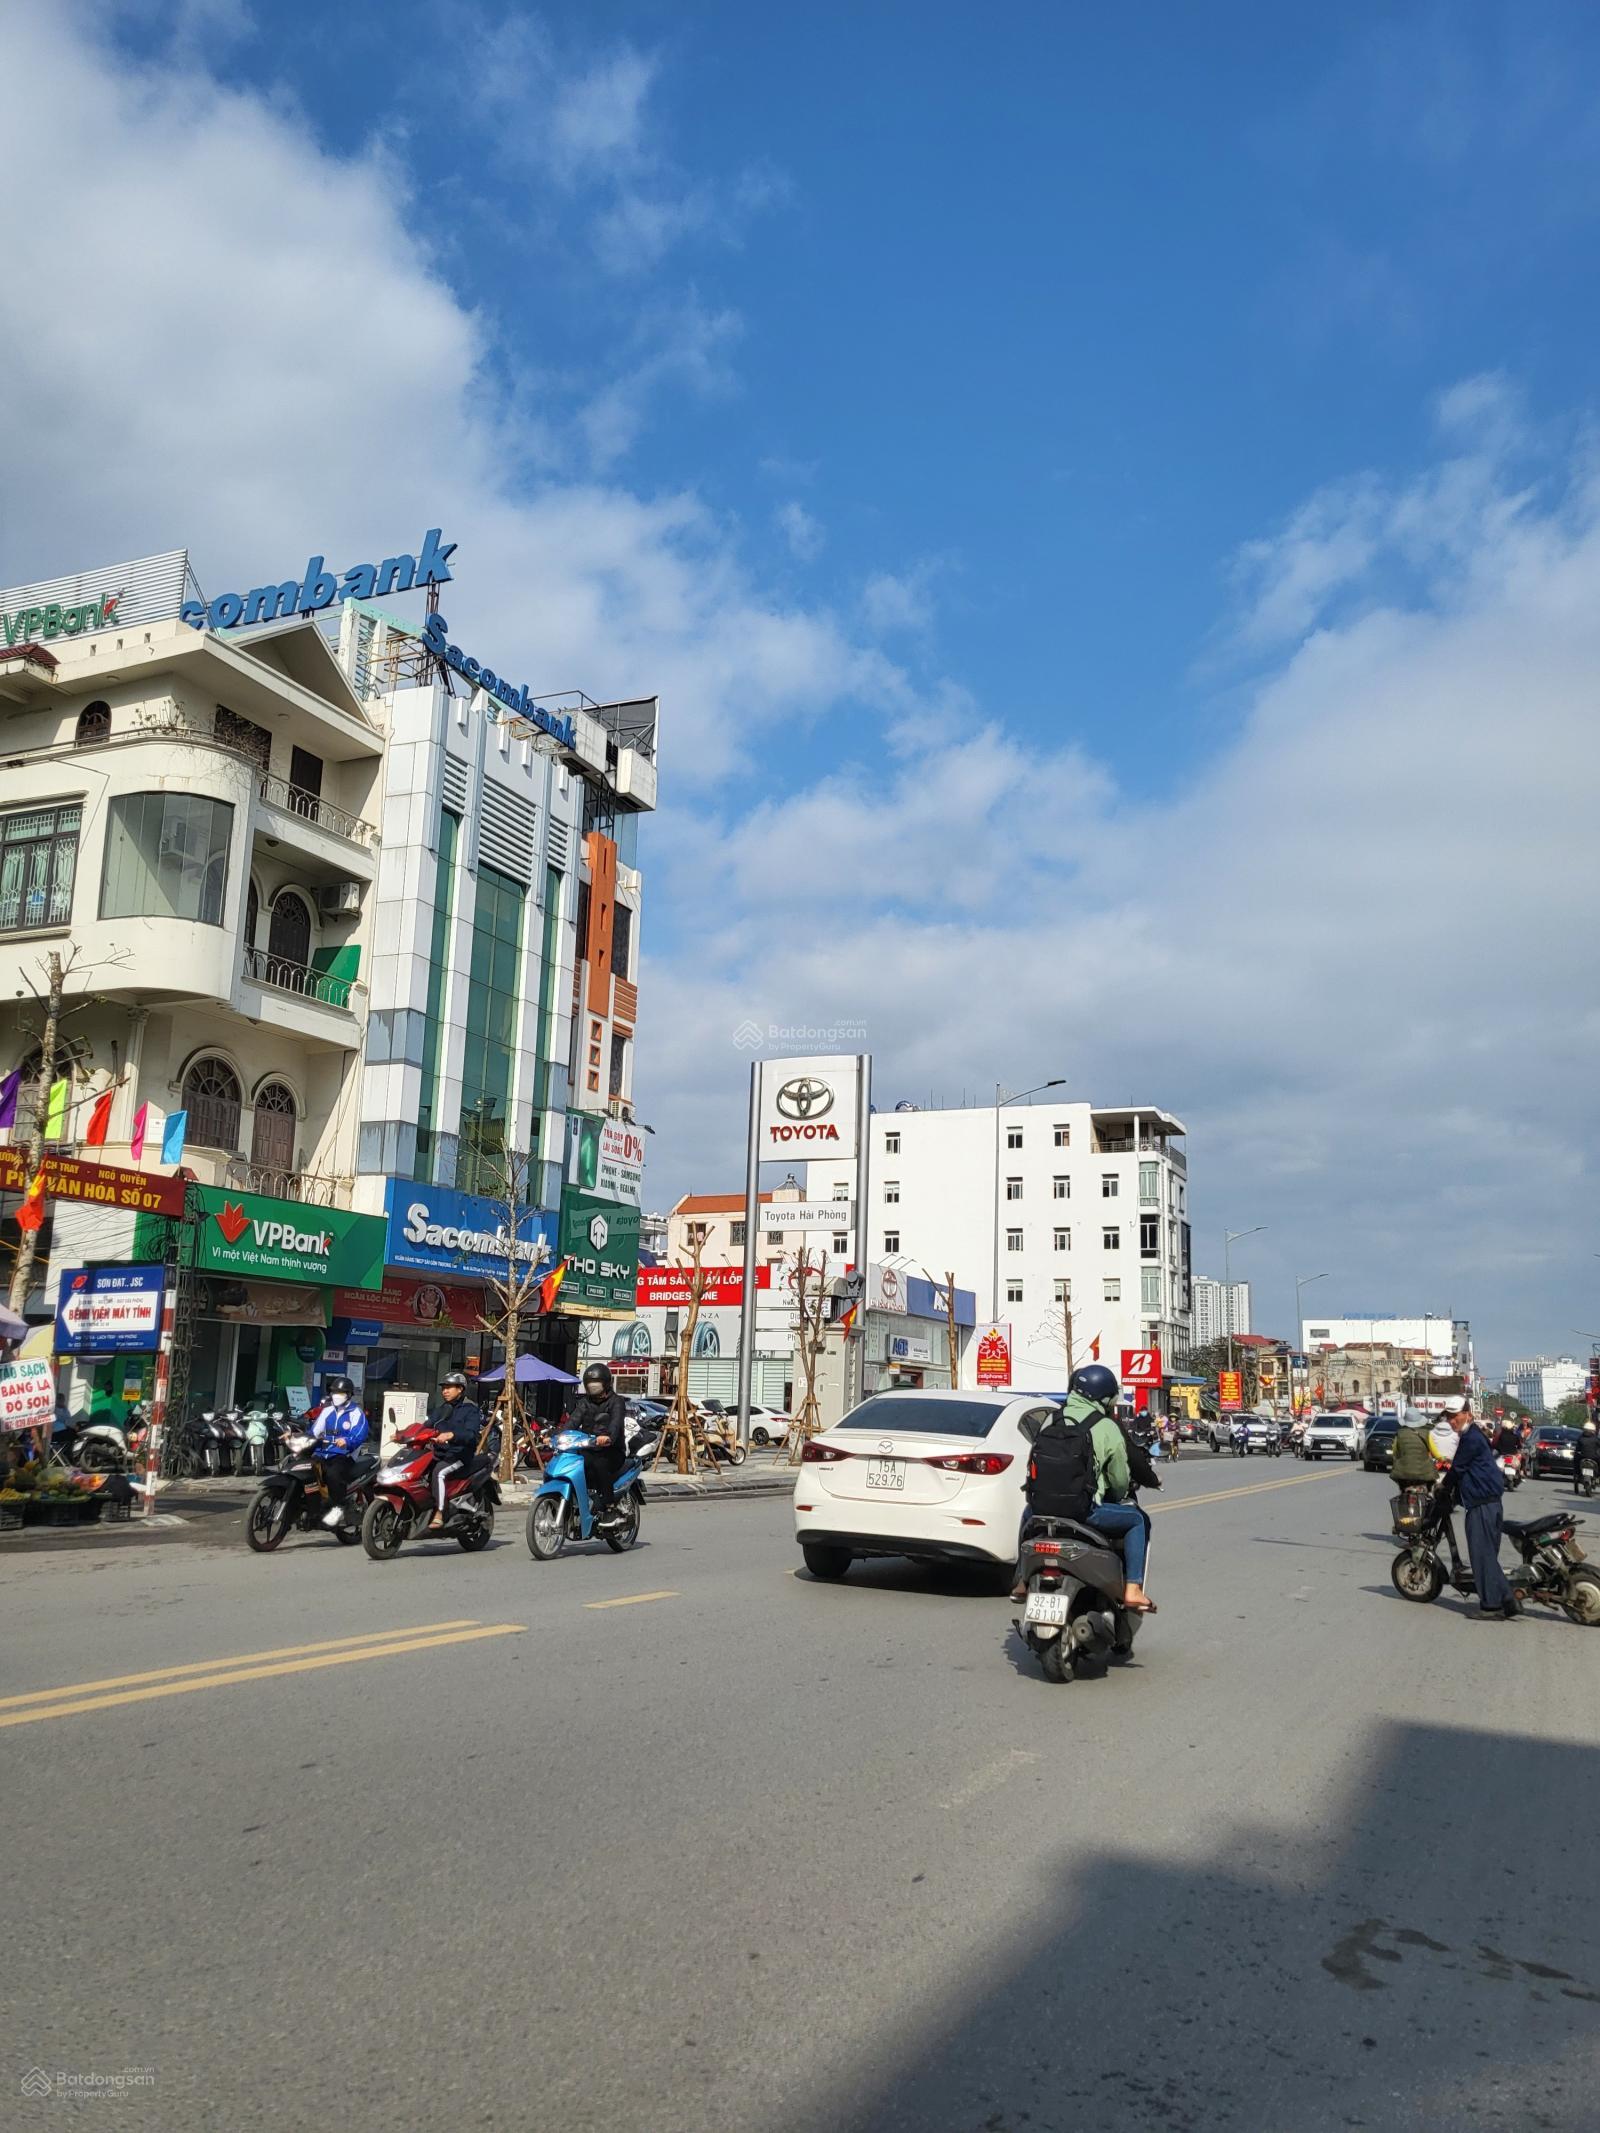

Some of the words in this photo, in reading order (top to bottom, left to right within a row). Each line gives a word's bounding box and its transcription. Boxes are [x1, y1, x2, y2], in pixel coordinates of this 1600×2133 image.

[3, 592, 119, 645] VPBank
[421, 613, 578, 750] Sacombank
[770, 1124, 840, 1143] TOYOTA
[624, 1134, 642, 1162] 0%
[60, 1163, 79, 1174] TRAY
[46, 1175, 81, 1196] VĂN
[84, 1181, 116, 1202] HÓA
[121, 1187, 142, 1206] SỐ
[143, 1195, 162, 1208] 07
[765, 1211, 795, 1223] Toyota
[800, 1210, 814, 1220] Hải
[818, 1209, 847, 1222] Phòng
[253, 1219, 330, 1256] VPBank
[404, 1203, 552, 1264] Sacombank
[212, 1246, 221, 1257] Vì
[222, 1249, 240, 1262] một
[242, 1251, 258, 1264] Việt
[260, 1254, 279, 1265] Nam
[281, 1257, 301, 1269] thịnh
[303, 1261, 327, 1273] vượng
[600, 1262, 630, 1280] SKY
[647, 1274, 667, 1285] TÂM
[723, 1271, 743, 1285] LỐP
[130, 1277, 143, 1287] JSC
[649, 1291, 718, 1301] BRIDGESONE
[112, 1303, 130, 1319] MÁY
[133, 1303, 152, 1319] TÍNH
[351, 1328, 379, 1337] Sacombank
[892, 1338, 909, 1356] ACB
[879, 1461, 897, 1472] 15A
[868, 1474, 903, 1487] 529.76
